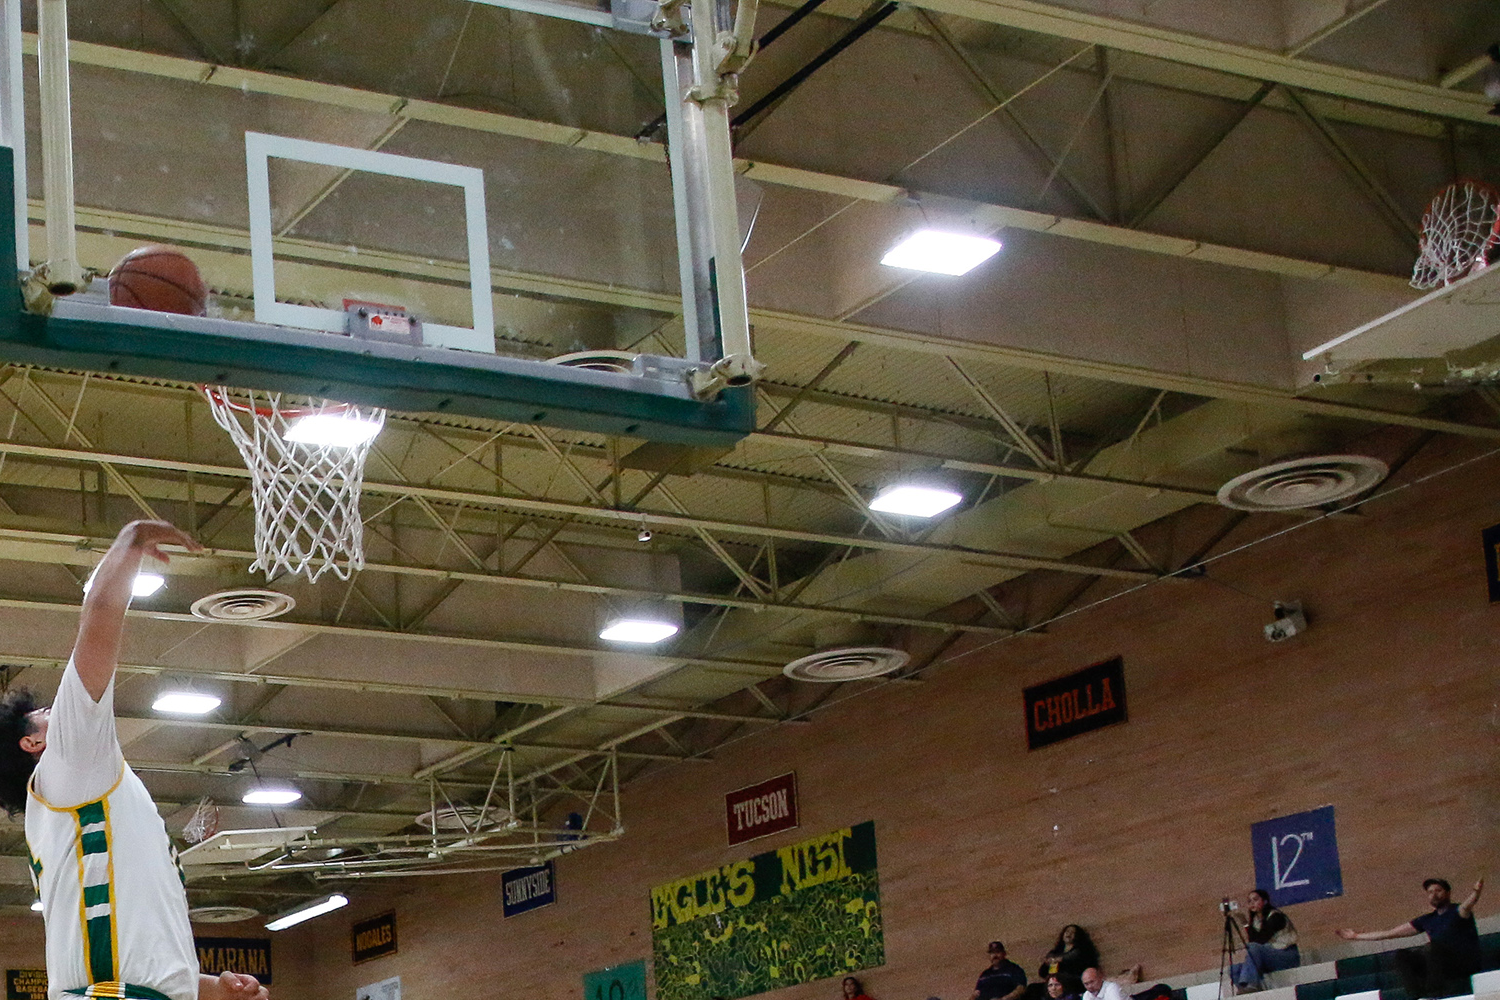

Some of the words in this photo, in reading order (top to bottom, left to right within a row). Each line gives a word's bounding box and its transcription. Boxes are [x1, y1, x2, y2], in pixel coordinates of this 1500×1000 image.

[1033, 677, 1115, 732] CHOLLA
[733, 788, 789, 830] TUCSON
[506, 869, 550, 905] SUNNYSIDE
[199, 948, 268, 974] MARANA
